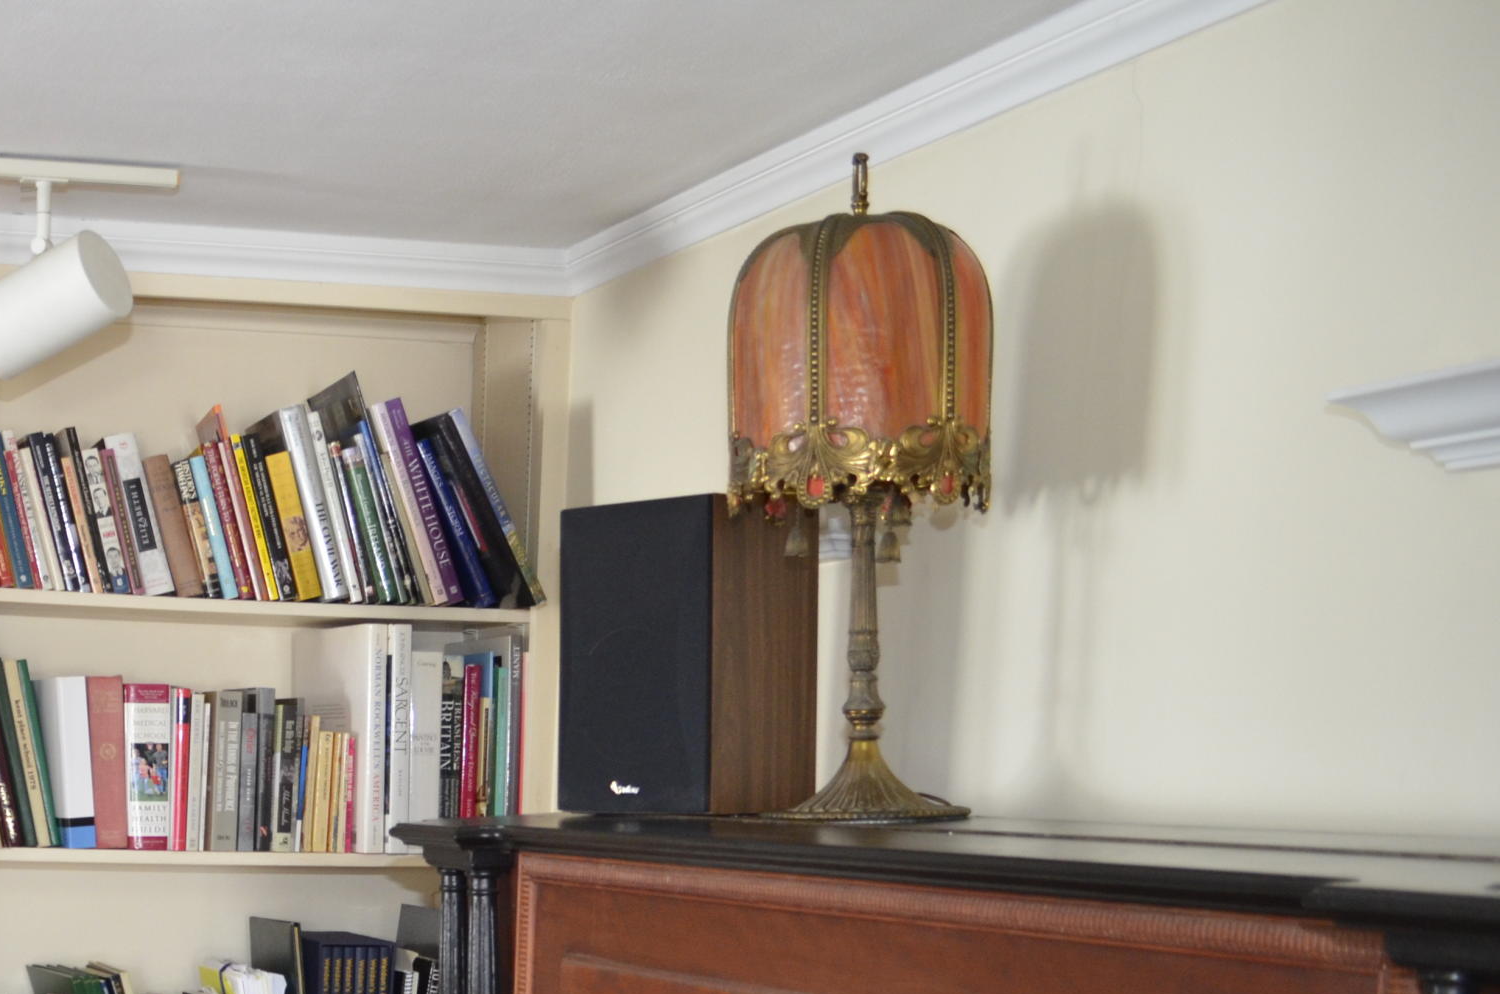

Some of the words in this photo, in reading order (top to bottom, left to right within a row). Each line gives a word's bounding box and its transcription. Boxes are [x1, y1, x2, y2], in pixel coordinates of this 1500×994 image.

[403, 442, 414, 457] THE
[407, 457, 435, 512] WHITE
[316, 502, 328, 523] THE
[446, 505, 464, 537] STORM
[321, 527, 335, 556] CIVIL
[423, 514, 451, 569] HOUSE
[328, 559, 342, 588] WAR
[374, 649, 382, 697] NORMAN
[512, 647, 520, 679] MANET
[14, 699, 24, 718] kent
[394, 677, 409, 754] SARGENT
[17, 720, 27, 740] place
[372, 701, 382, 769] ROCKWELL'S
[440, 700, 454, 770] BRITAIN
[453, 701, 462, 761] TREASURES
[21, 743, 32, 768] school
[371, 772, 381, 822] AMERICA
[344, 959, 352, 992] Weldon's
[357, 959, 365, 992] Weldon's
[368, 959, 376, 992] Weldon's
[380, 957, 388, 990] Weldon's
